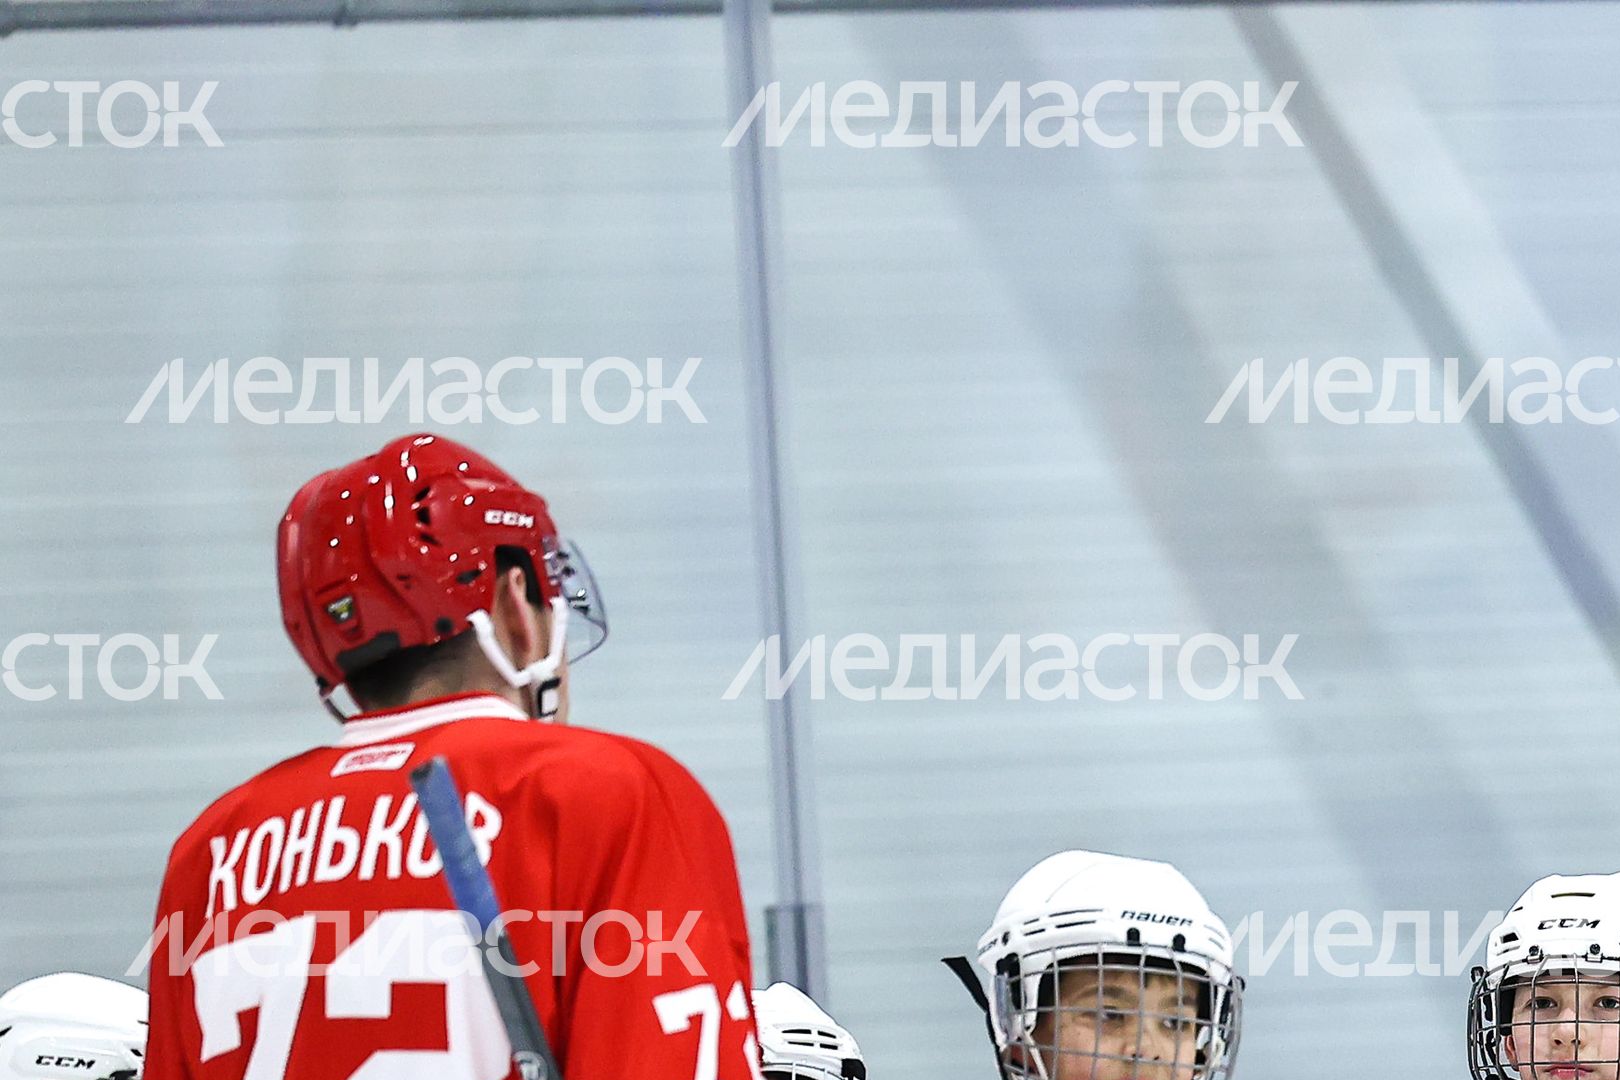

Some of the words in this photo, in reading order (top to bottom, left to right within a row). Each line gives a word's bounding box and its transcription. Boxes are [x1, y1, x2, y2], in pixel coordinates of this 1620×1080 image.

[484, 509, 533, 528] CCM
[1537, 917, 1601, 931] CCM
[35, 1054, 96, 1070] CCM
